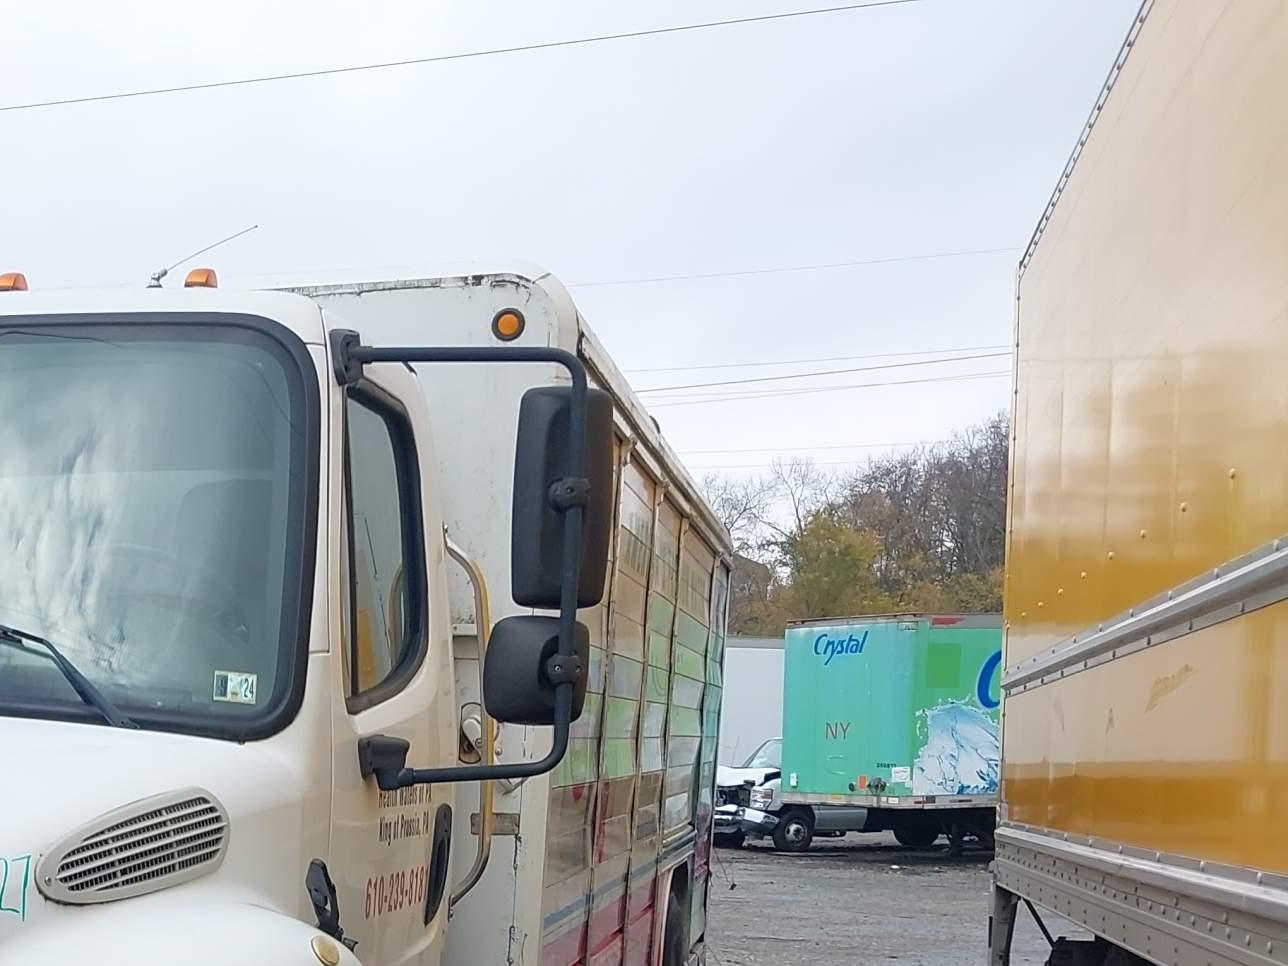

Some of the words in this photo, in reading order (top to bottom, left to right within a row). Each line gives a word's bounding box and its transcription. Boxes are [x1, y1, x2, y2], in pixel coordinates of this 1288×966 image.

[814, 631, 869, 665] Crystal
[825, 722, 851, 740] NY
[379, 815, 392, 846] King
[393, 815, 399, 840] of
[423, 810, 429, 834] PA
